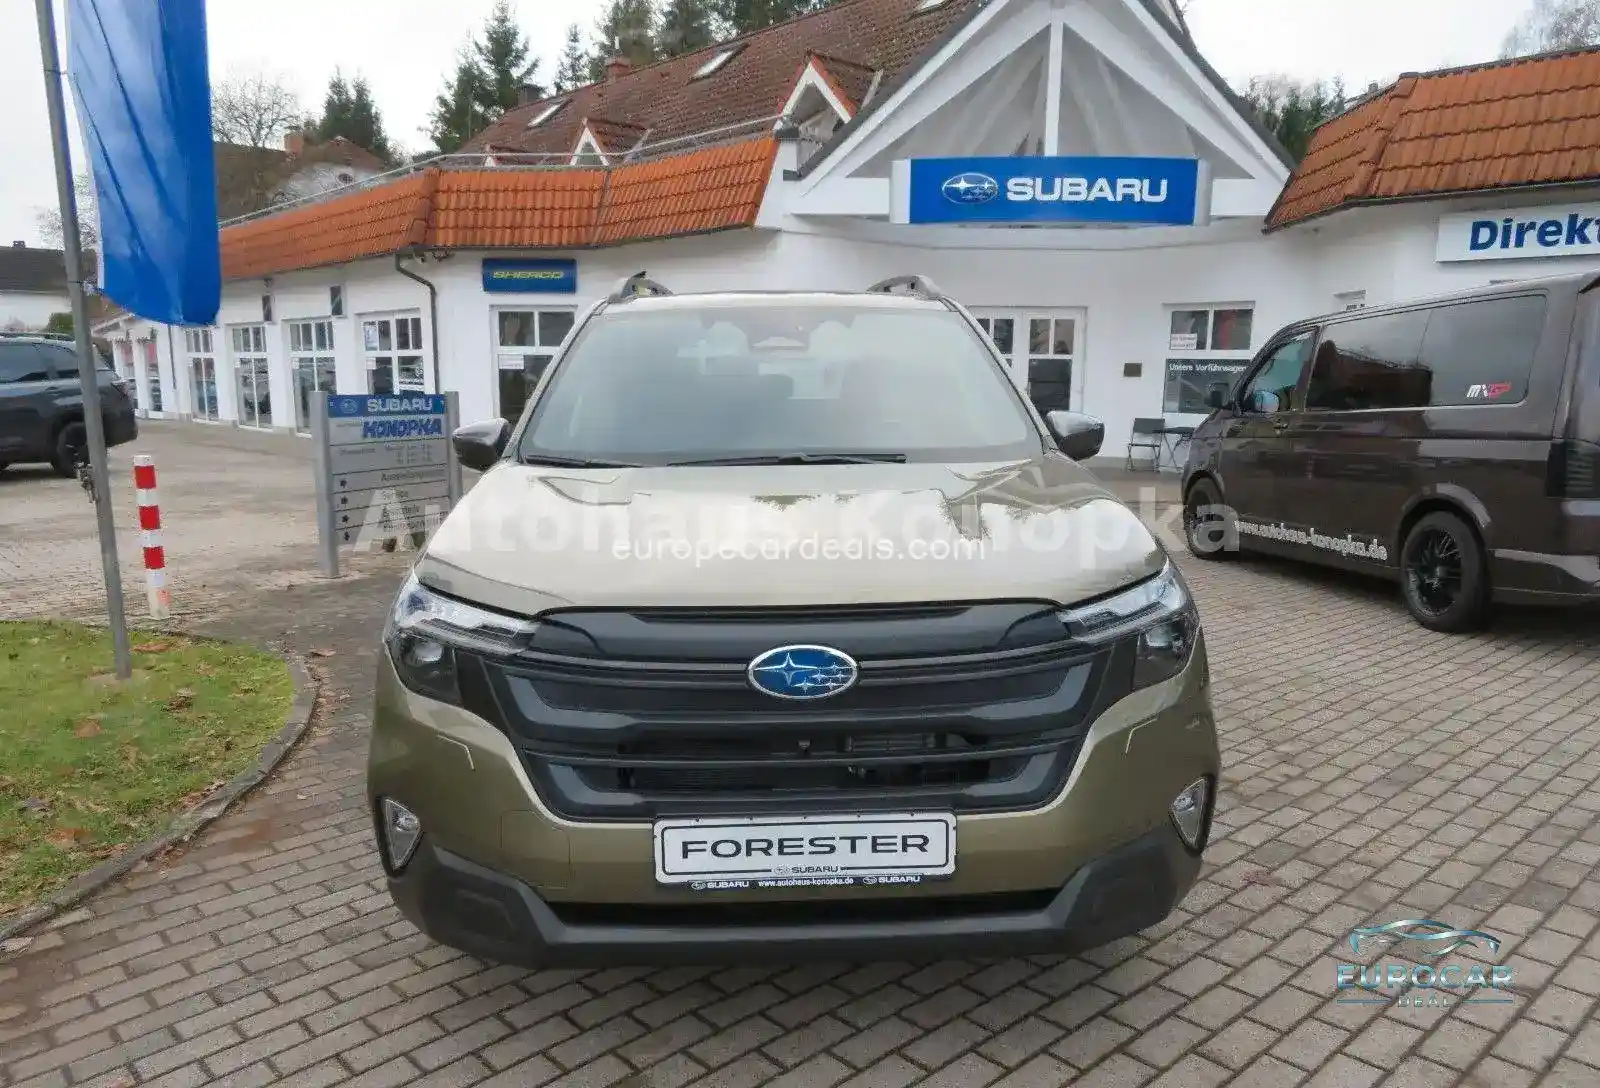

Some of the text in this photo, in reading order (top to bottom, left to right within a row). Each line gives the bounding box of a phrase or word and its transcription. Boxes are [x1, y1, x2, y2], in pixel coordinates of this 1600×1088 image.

[1007, 177, 1168, 203] SUBARU
[1169, 364, 1193, 372] Unsere
[367, 398, 433, 412] SUBARU
[363, 418, 442, 439] KONOPKA
[682, 834, 930, 859] FORESTER
[792, 865, 839, 874] SUBARU
[706, 875, 920, 889] SUBARU www.autohaus-konopka.de SUBARU
